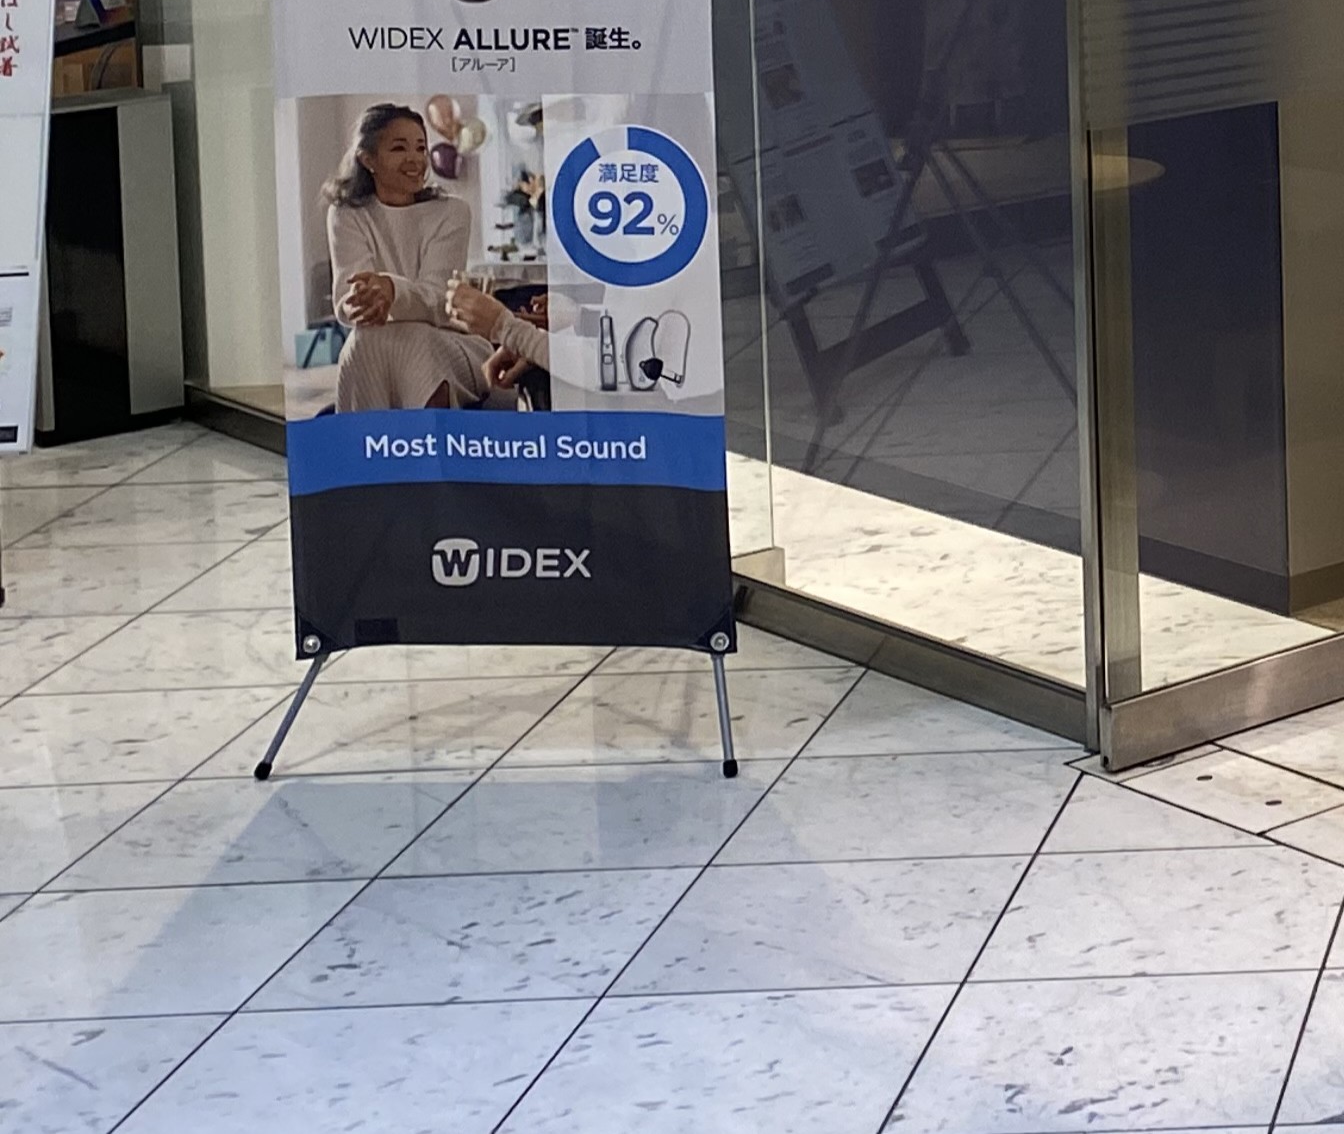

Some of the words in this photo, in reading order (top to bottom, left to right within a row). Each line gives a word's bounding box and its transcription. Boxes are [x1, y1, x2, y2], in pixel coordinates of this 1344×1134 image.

[349, 26, 444, 51] WIDEX
[598, 163, 660, 184] 満足度
[365, 434, 437, 460] Most
[446, 433, 547, 459] Natural
[556, 435, 647, 460] Sound
[431, 537, 592, 587] WIDEX
